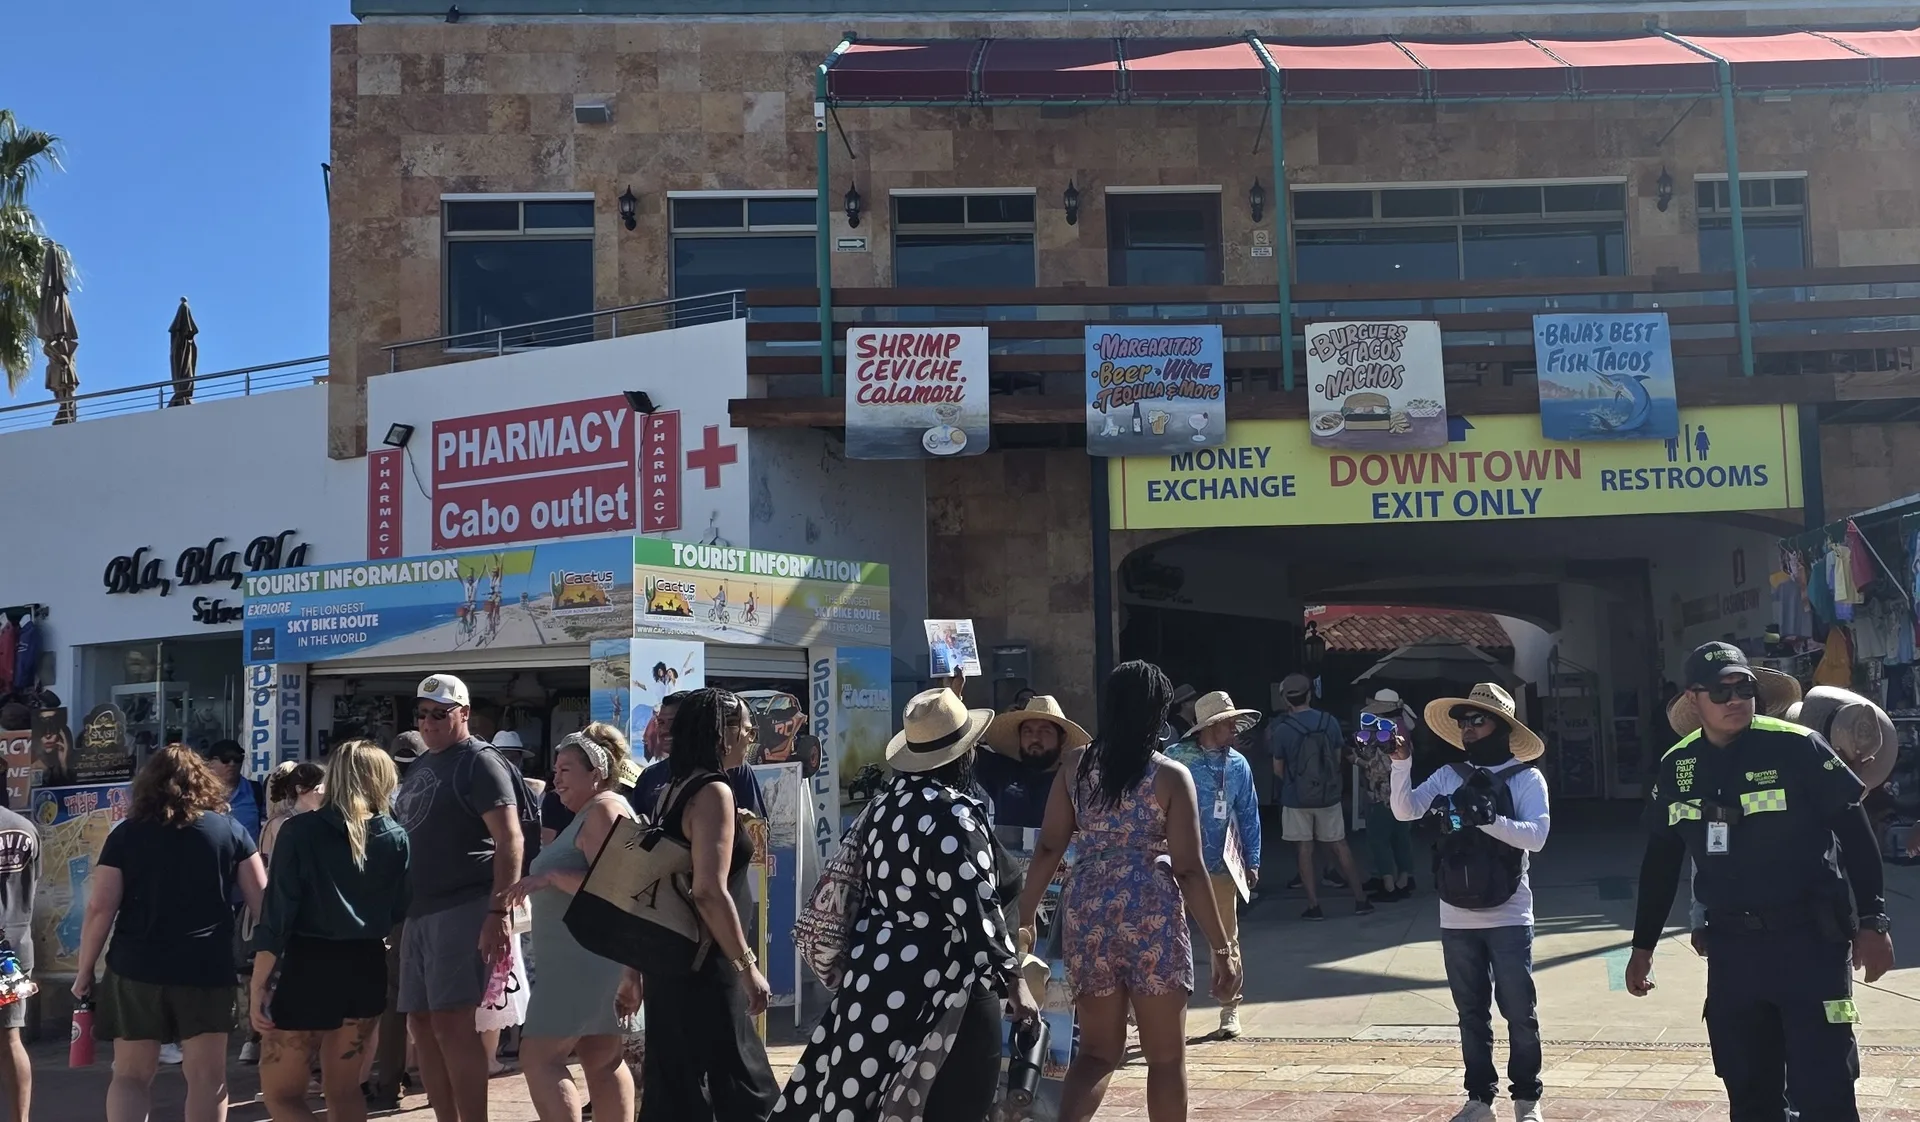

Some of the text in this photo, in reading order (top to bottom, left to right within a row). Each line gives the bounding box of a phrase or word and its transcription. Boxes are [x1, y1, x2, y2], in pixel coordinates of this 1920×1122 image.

[856, 333, 961, 359] SHRIMP
[1311, 323, 1408, 363] BURGUERS
[1544, 321, 1659, 348] BAJA'S BEST
[1339, 338, 1403, 366] TACOS
[1546, 346, 1653, 373] FISH TACOS
[1099, 361, 1153, 388] Beer
[1325, 362, 1406, 401] NACHOS
[856, 382, 966, 404] Calamari
[1097, 380, 1221, 414] TEQUILA & More
[438, 407, 627, 472] PHARMACY
[652, 418, 667, 526] PHARMACY
[1170, 446, 1272, 472] MONEY
[1329, 448, 1582, 487] DOWNTOWN
[1147, 475, 1296, 502] EXCHANGE
[1601, 464, 1769, 492] RESTROOMS
[379, 456, 392, 556] PHARMACY
[439, 483, 629, 539] Cabo outlet
[1371, 487, 1543, 520] EXIT ONLY
[103, 529, 311, 597] Bla, Bla, Bla
[672, 542, 861, 583] TOURIST INFORMATION
[246, 559, 459, 597] TOURIST INFORMATION
[564, 571, 613, 585] Cactus
[656, 579, 696, 594] Cactus
[247, 601, 292, 616] EXPLORE
[300, 602, 365, 617] THE LONGEST
[814, 606, 881, 620] SKY BIKE ROUTE
[825, 595, 872, 607] THE LONGEST
[287, 614, 379, 634] SKY BIKE ROUTE
[831, 622, 847, 632] THE
[847, 623, 873, 634] WORLD
[297, 631, 367, 648] IN THE WORLD
[68, 801, 97, 817] map
[630, 877, 661, 910] A
